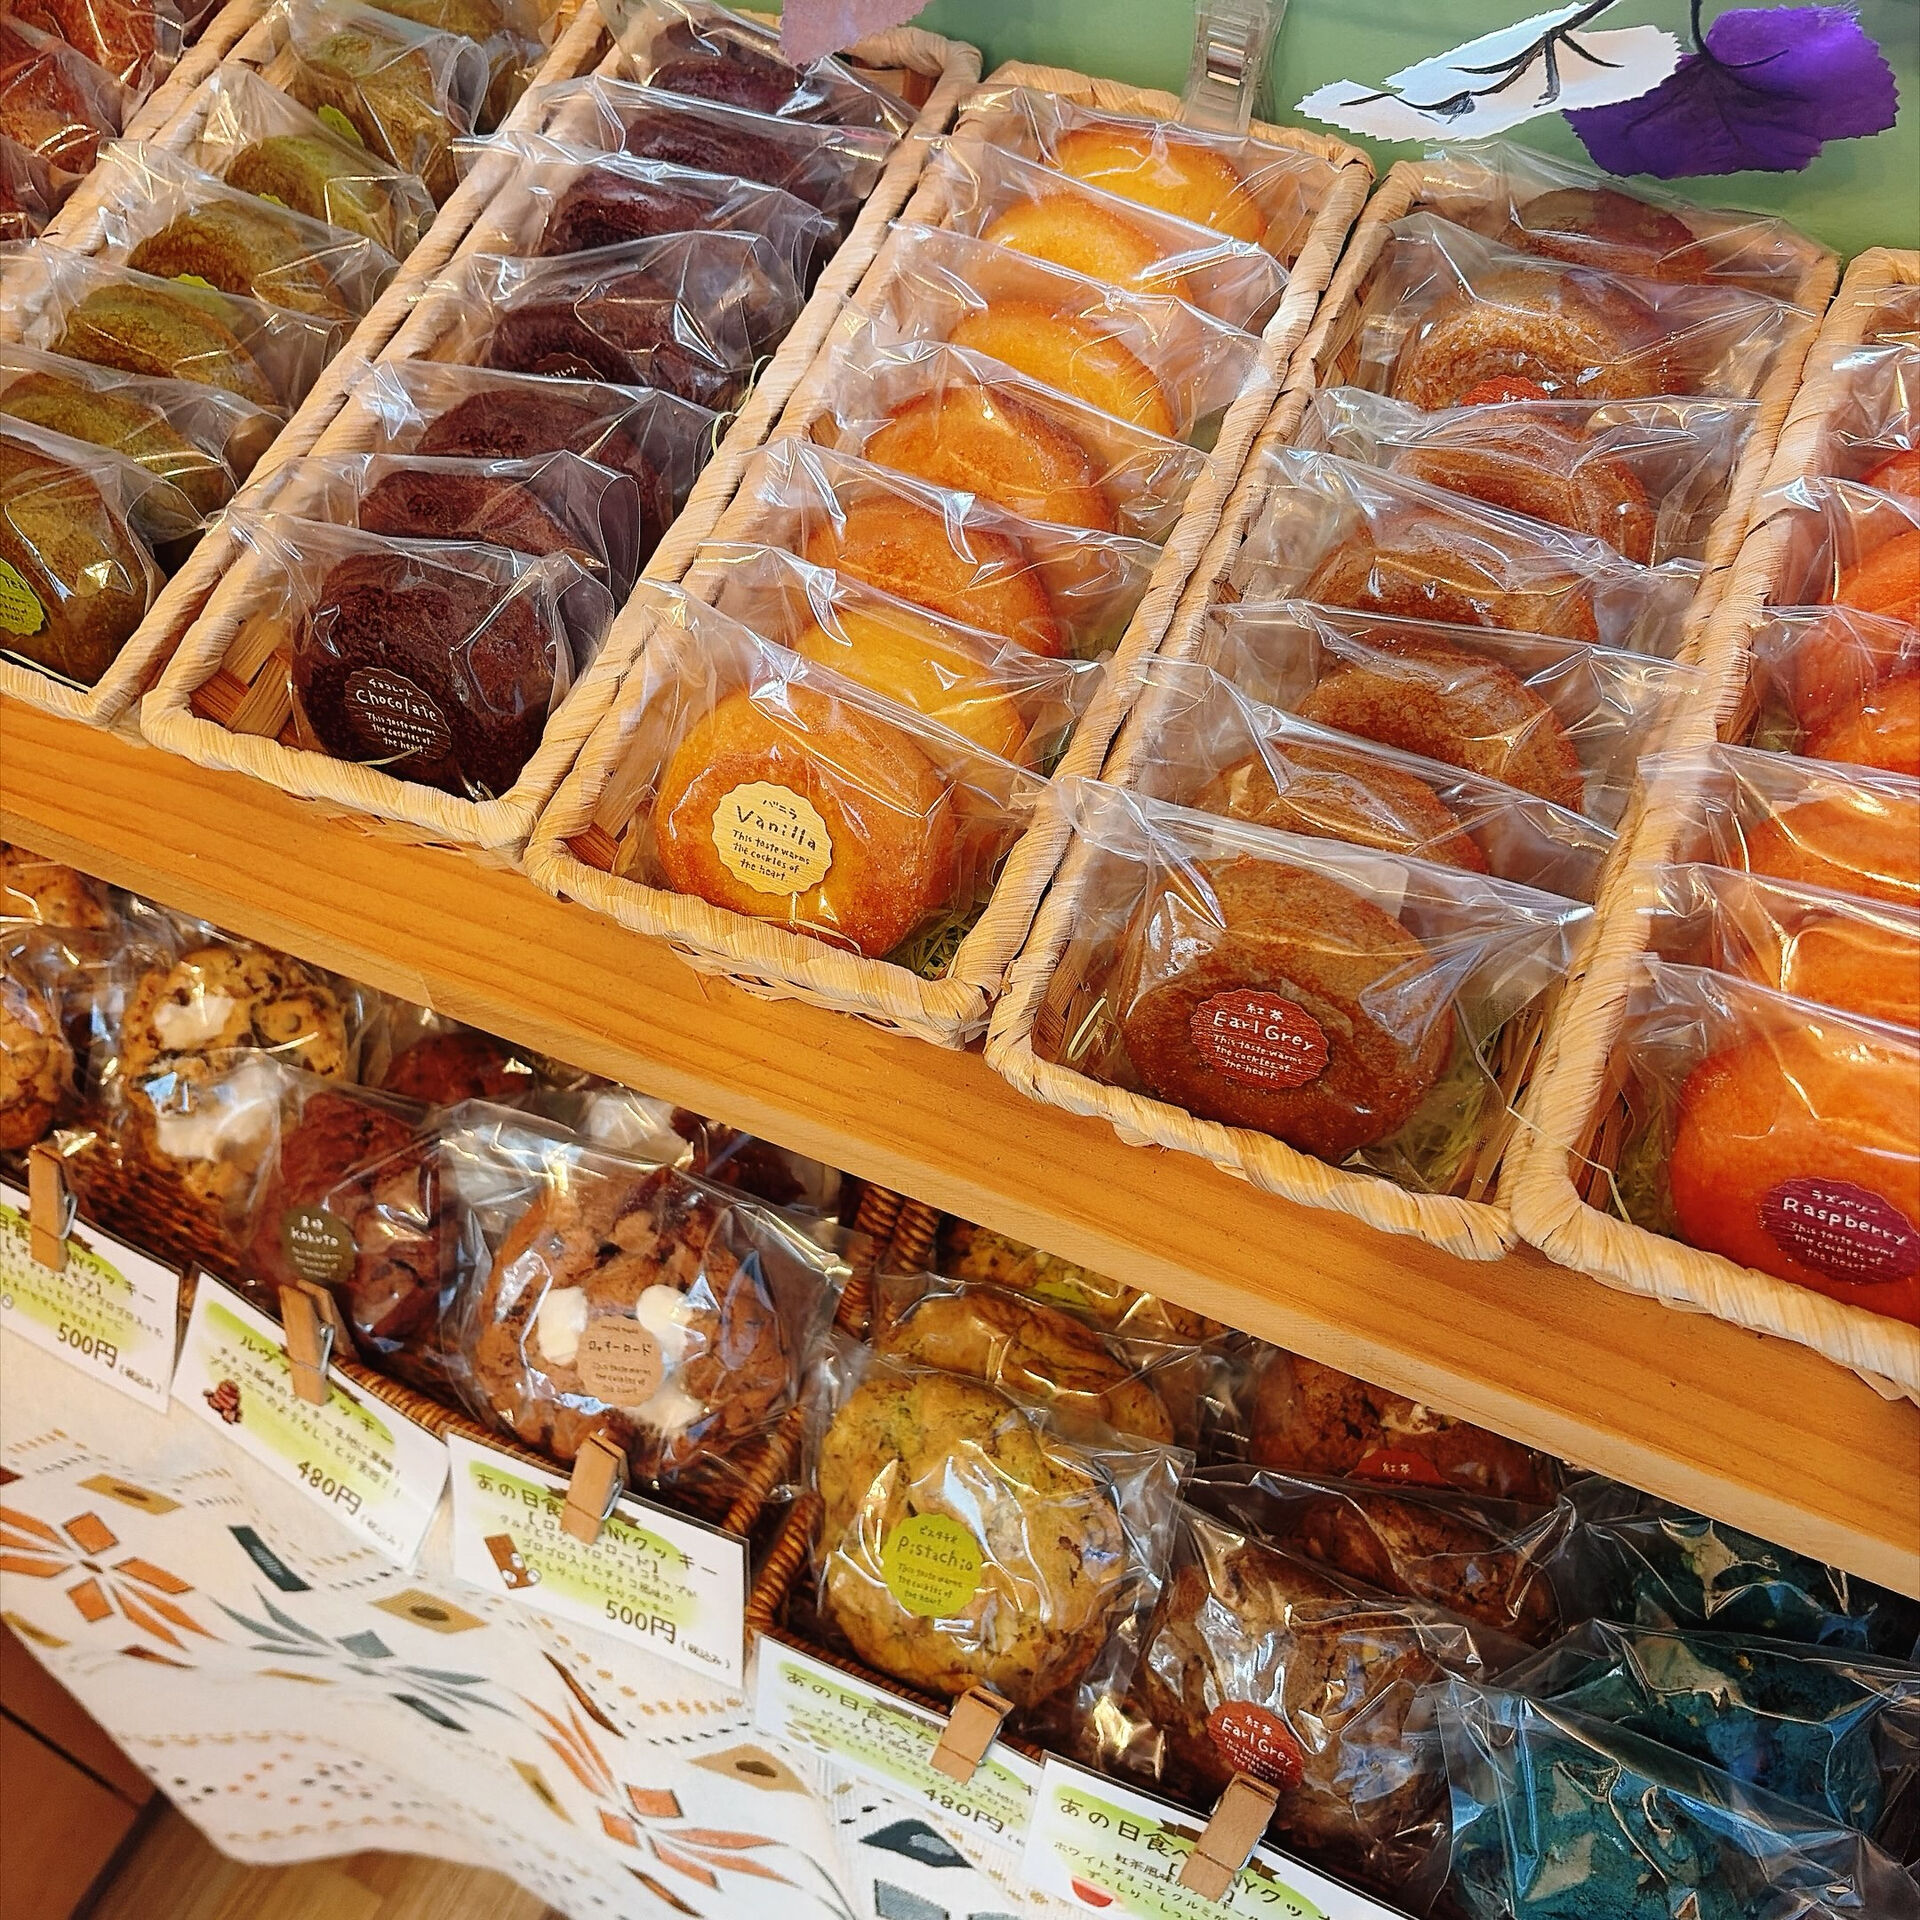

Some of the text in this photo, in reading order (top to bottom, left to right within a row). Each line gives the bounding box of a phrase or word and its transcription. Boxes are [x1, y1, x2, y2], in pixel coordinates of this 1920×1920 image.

[356, 690, 437, 722] Chocolate
[762, 800, 797, 820] バニラ
[737, 805, 816, 851] Vanilla
[733, 829, 810, 865] This taste warms
[733, 842, 800, 874] the cockles of
[740, 858, 756, 871] the
[1246, 1002, 1284, 1023] 紅茶
[1213, 1010, 1315, 1051] Earl Grey
[1213, 1034, 1302, 1065] This taste warms
[1214, 1045, 1292, 1073] the cockles of
[1223, 1059, 1241, 1070] the
[1811, 1189, 1879, 1215] ラズベリー
[1782, 1197, 1908, 1246] Raspberry
[1790, 1221, 1897, 1259] This taste warms
[1794, 1234, 1883, 1265] the cockles of
[1805, 1248, 1826, 1261] the
[57, 1322, 119, 1368] 500円
[297, 1460, 363, 1516] 480円
[896, 1535, 973, 1571] Pistachio
[605, 1600, 677, 1645] 500円
[1221, 1717, 1293, 1766] Earl Grey
[922, 1787, 1004, 1835] 480円
